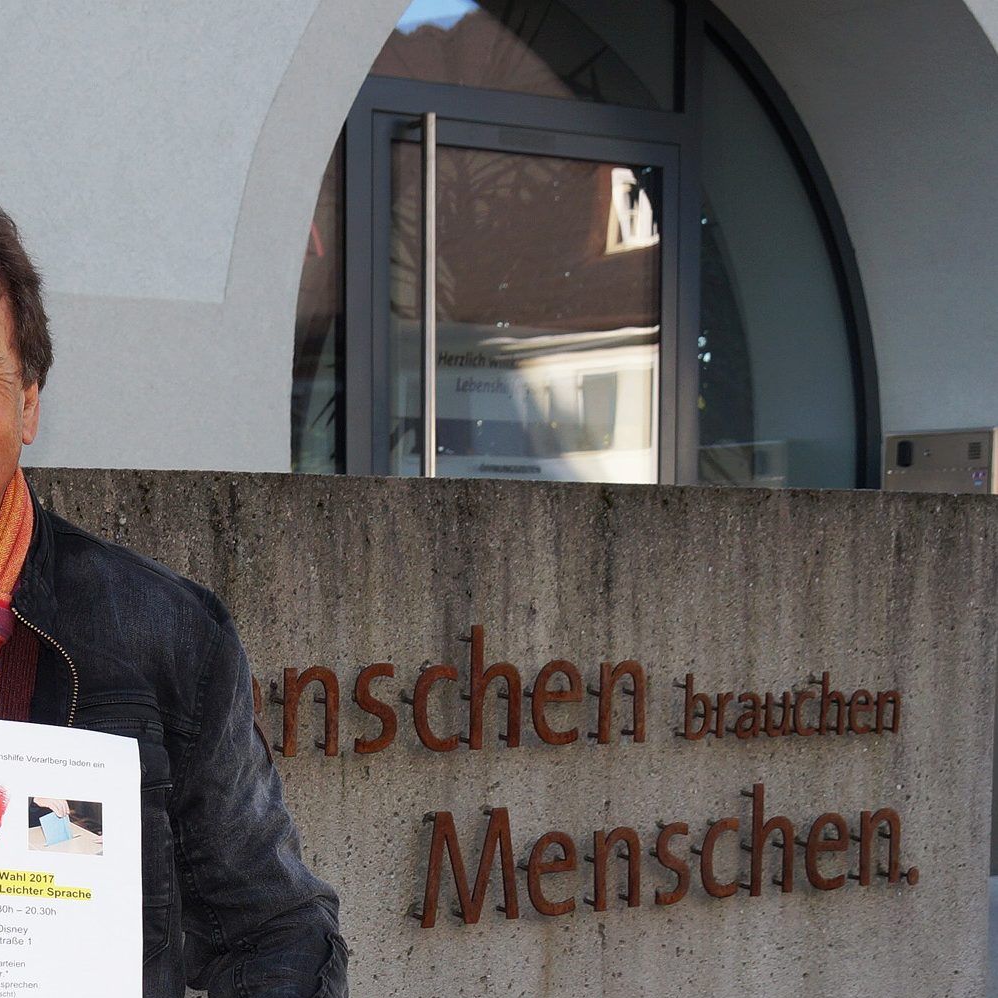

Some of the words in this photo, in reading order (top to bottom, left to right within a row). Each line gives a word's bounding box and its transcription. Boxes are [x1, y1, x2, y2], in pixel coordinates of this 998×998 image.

[252, 625, 646, 762] nschen
[685, 672, 902, 741] brauchen
[26, 755, 68, 767] Vorarlberg
[70, 758, 91, 768] laden
[93, 761, 105, 769] ein
[421, 784, 920, 928] Menschen.
[29, 873, 54, 883] 2017
[0, 884, 43, 896] Leichter
[47, 887, 92, 900] Sprache
[25, 906, 57, 916] 20.30h
[27, 937, 33, 946] 1
